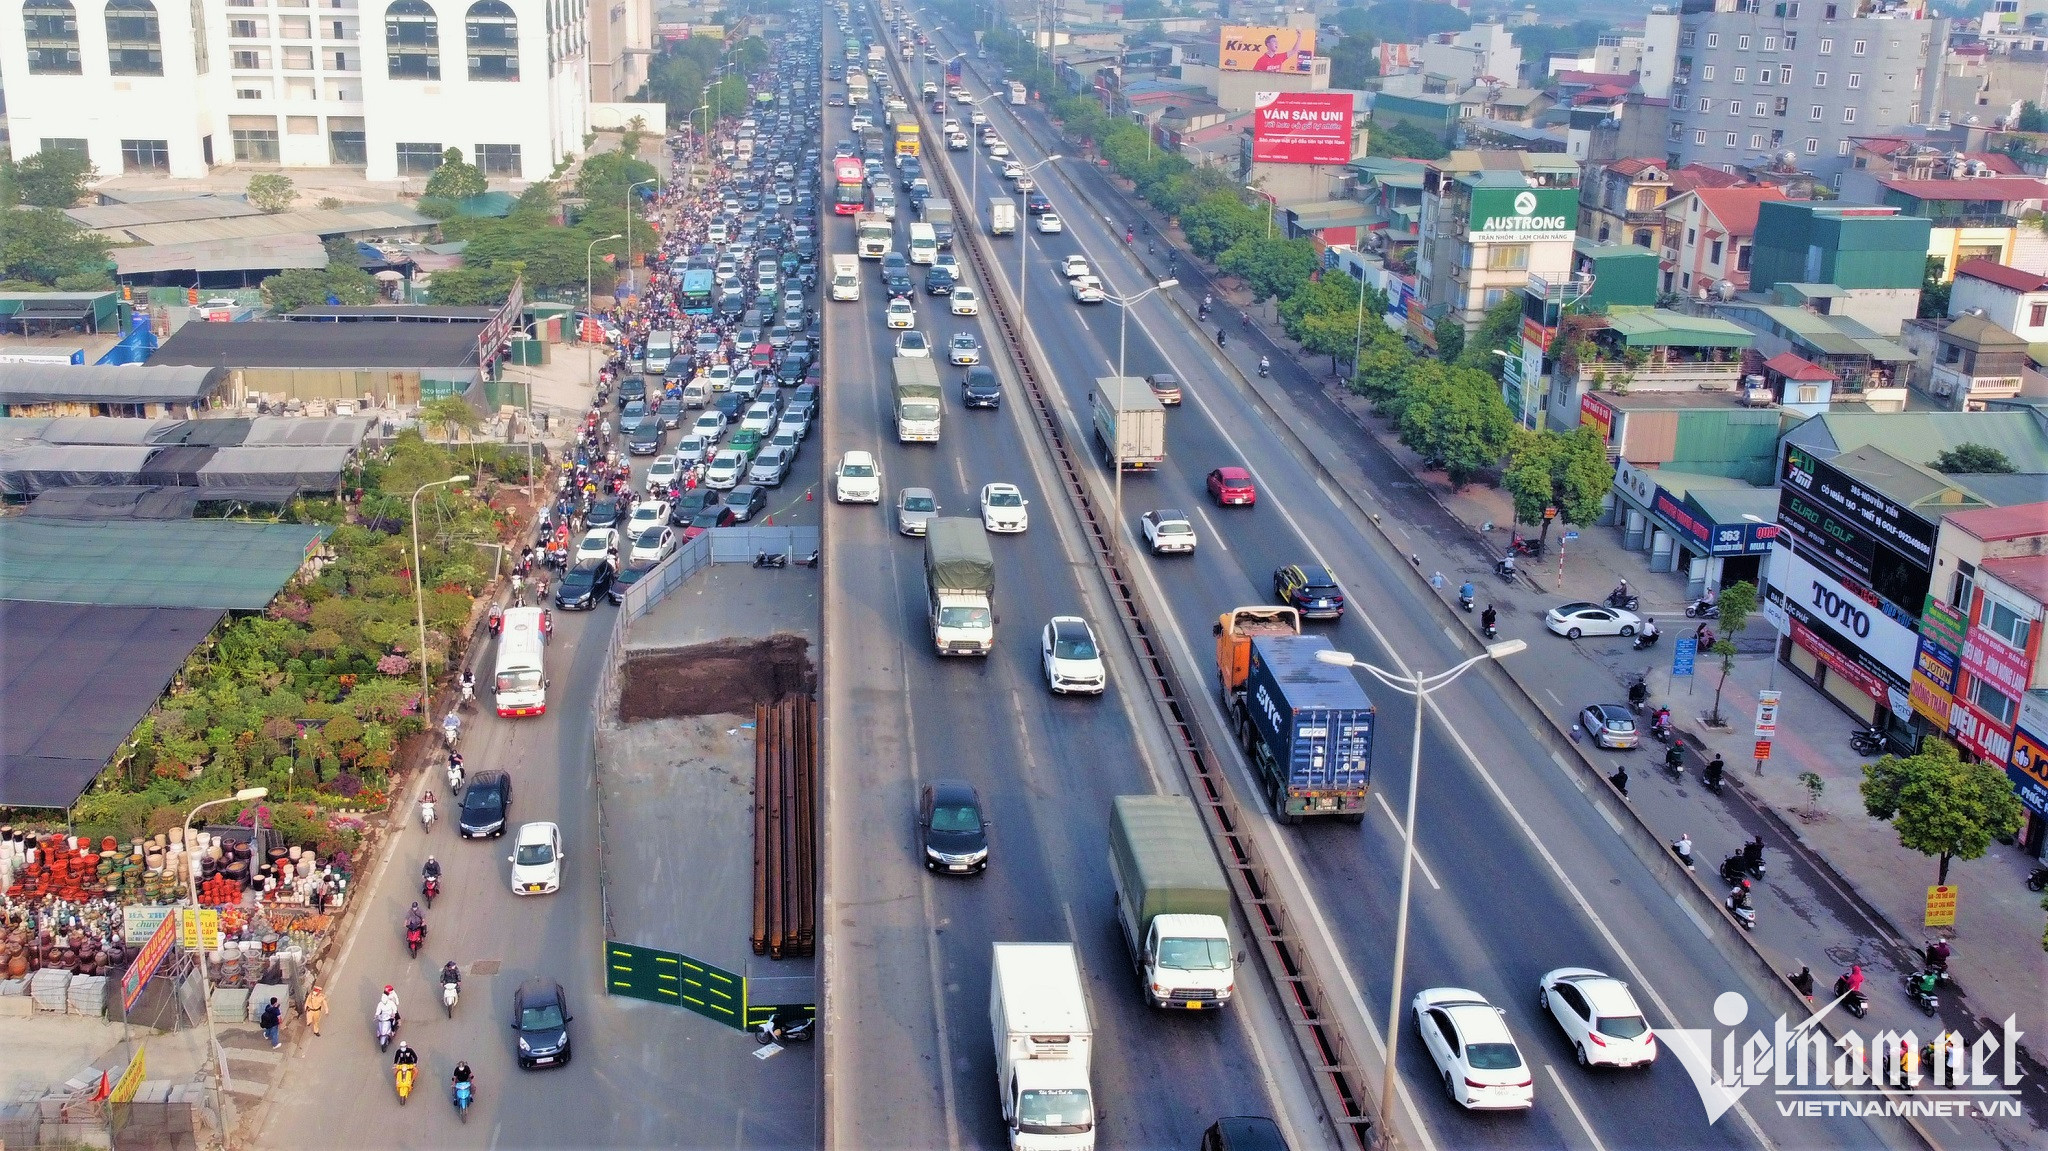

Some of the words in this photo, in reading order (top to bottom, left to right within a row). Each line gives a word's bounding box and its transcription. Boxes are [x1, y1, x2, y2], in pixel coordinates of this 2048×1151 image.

[1225, 40, 1262, 52] Kixx
[1263, 108, 1289, 120] VÁN
[1292, 109, 1317, 121] SÀN
[1321, 112, 1343, 121] UNI
[1483, 216, 1565, 230] AUSTRONG
[1720, 530, 1740, 541] 363
[1749, 543, 1765, 551] MUA
[1812, 580, 1870, 638] TOTO
[1927, 658, 1951, 683] JOTUN
[1950, 702, 1977, 741] ĐIỆN
[1978, 723, 2011, 763] LẠNH
